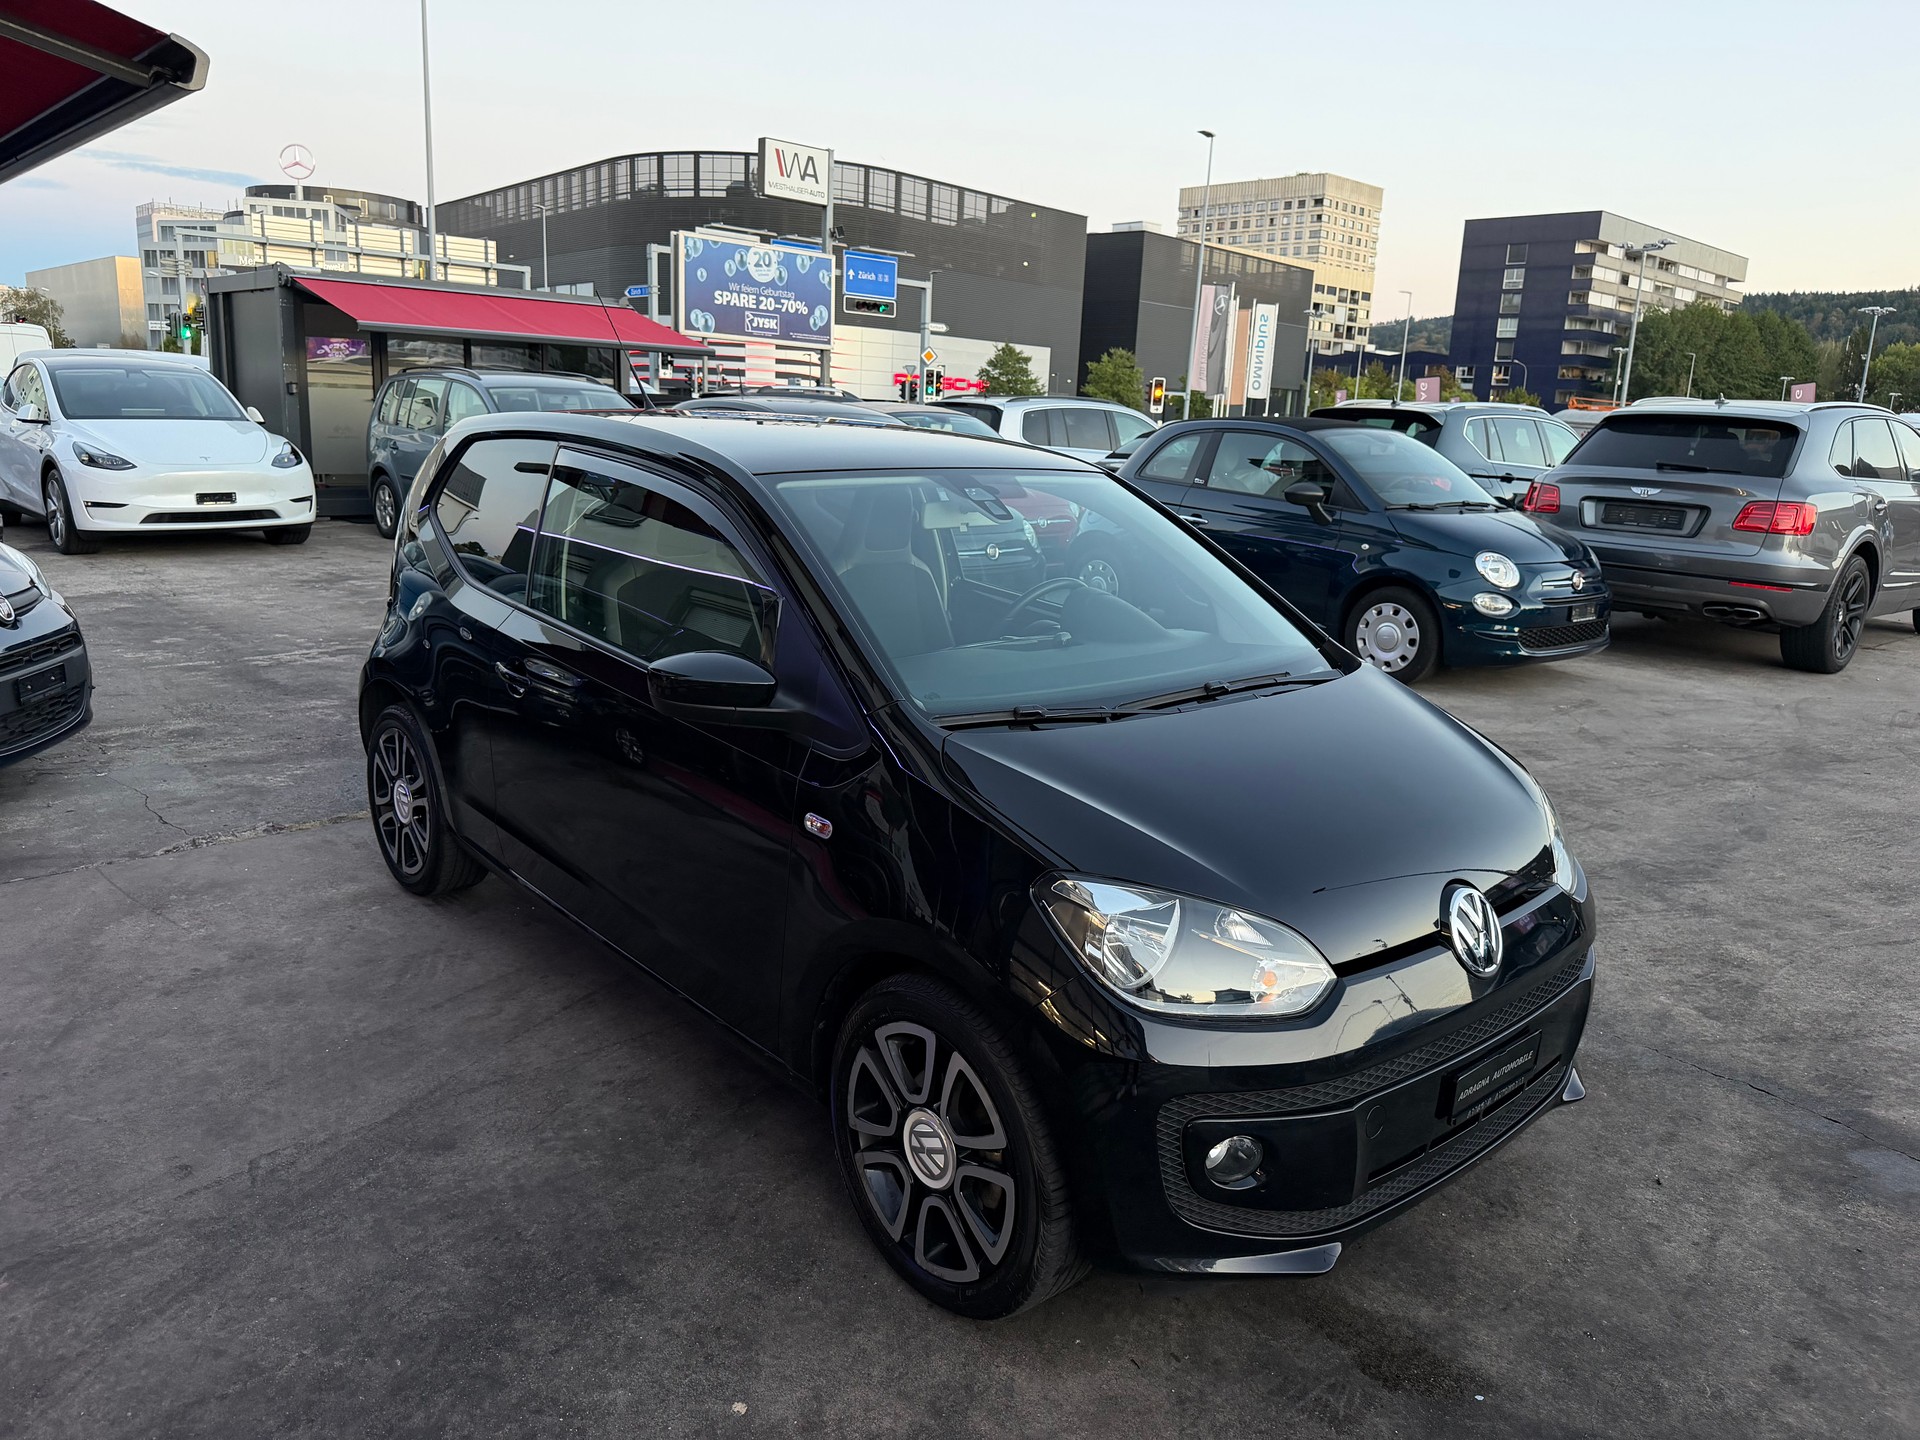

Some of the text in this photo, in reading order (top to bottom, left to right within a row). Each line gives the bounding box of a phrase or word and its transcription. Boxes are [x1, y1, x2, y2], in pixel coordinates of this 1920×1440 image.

[753, 251, 771, 268] 20
[714, 290, 757, 309] SPARE
[728, 282, 740, 292] Wir
[760, 286, 795, 300] Geburtstag
[752, 316, 778, 330] JYSK
[1458, 1050, 1534, 1102] ADRAGNA AUTOMOBILE
